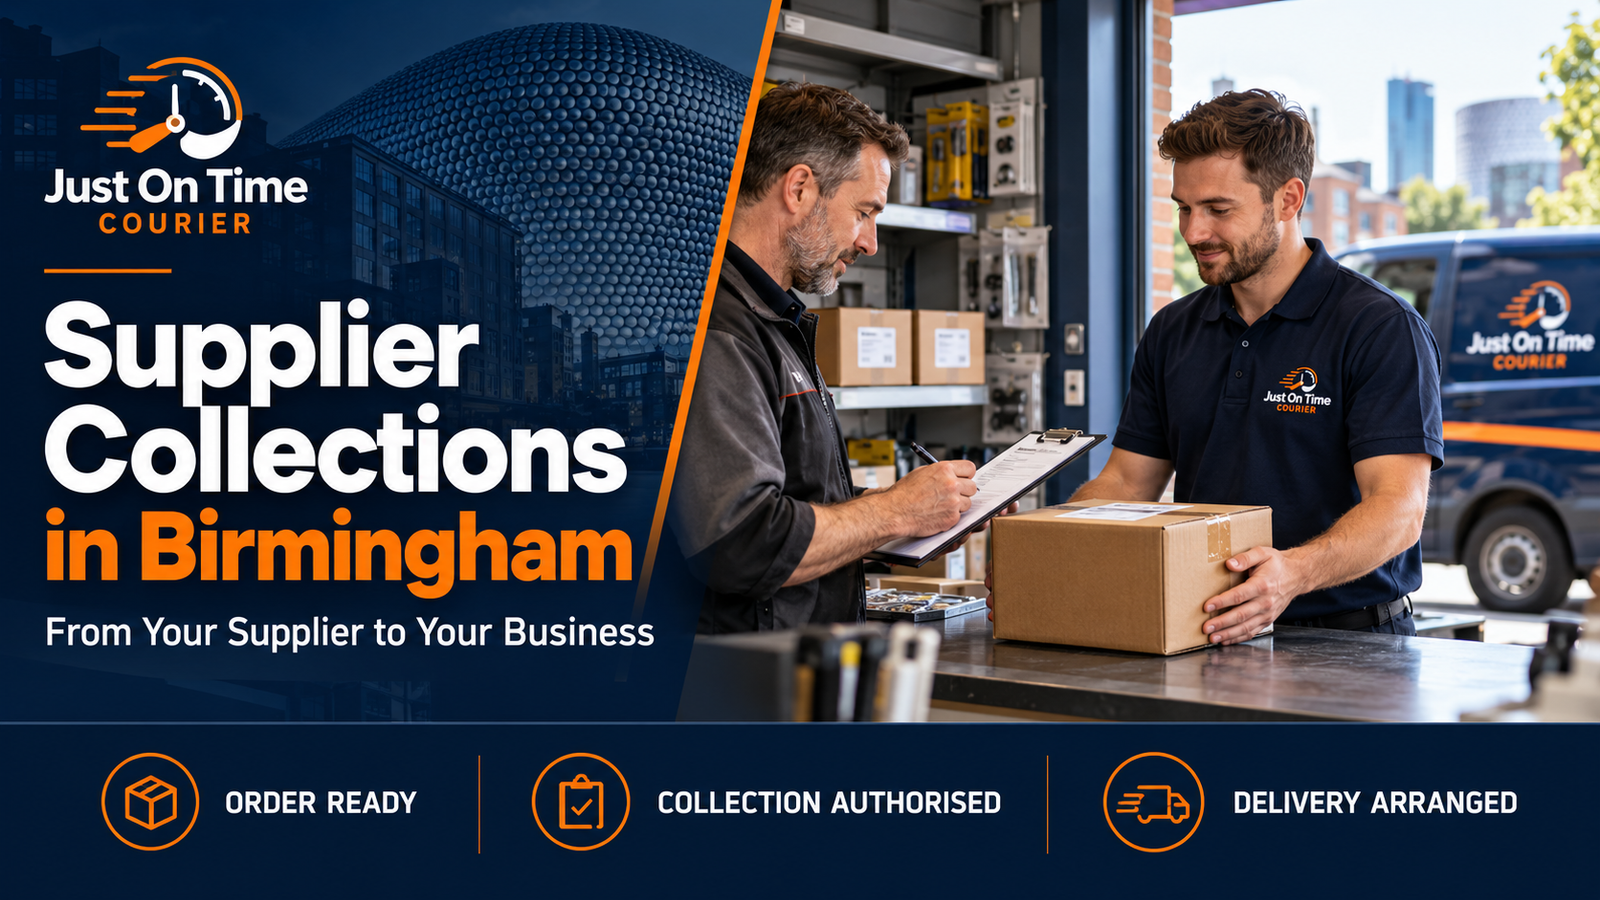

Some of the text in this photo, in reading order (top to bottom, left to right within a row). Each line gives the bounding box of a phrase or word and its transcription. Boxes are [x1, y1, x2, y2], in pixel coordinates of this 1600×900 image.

[1466, 329, 1596, 354] Just On Time
[1492, 354, 1567, 371] COURIER
[1263, 390, 1332, 406] Just On Time
[1276, 403, 1317, 414] COURIER
